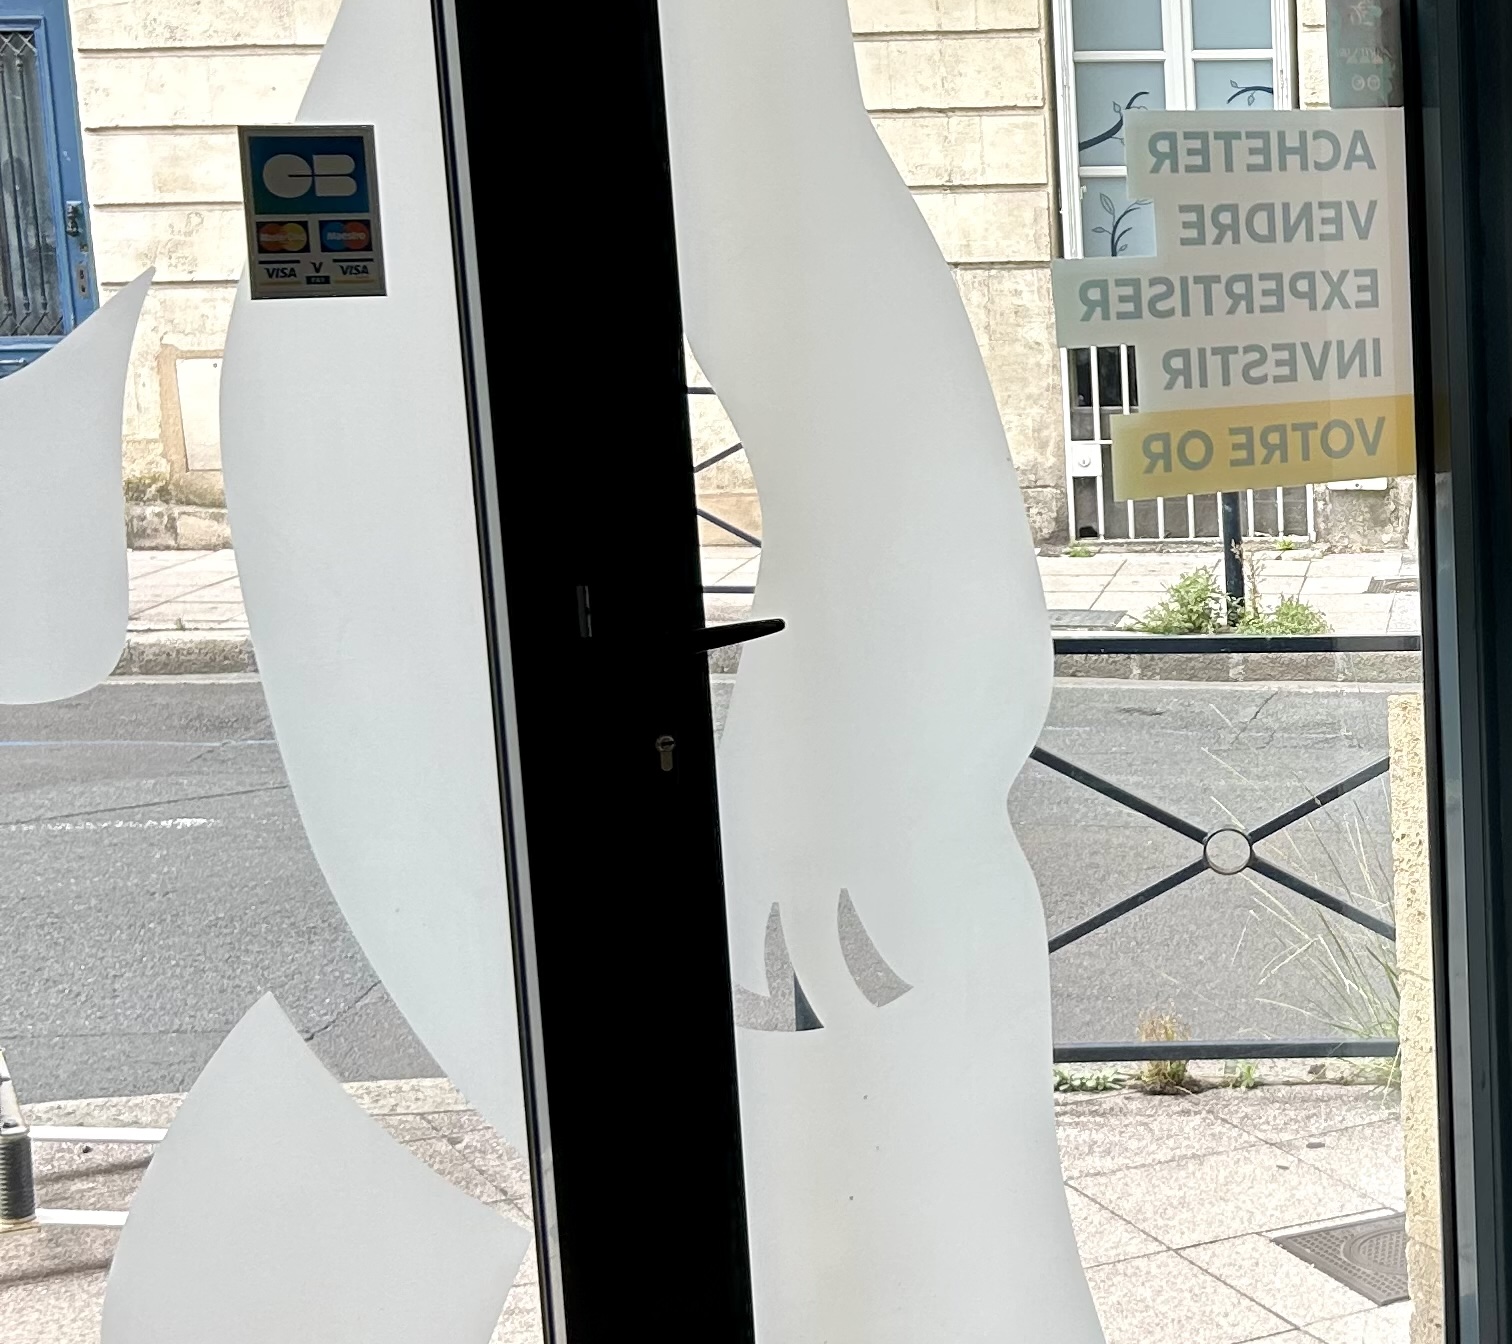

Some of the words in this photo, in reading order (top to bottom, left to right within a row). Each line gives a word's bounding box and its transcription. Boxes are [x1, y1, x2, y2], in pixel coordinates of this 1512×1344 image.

[262, 153, 358, 199] CB
[264, 267, 297, 279] VISA
[338, 264, 369, 276] VISA
